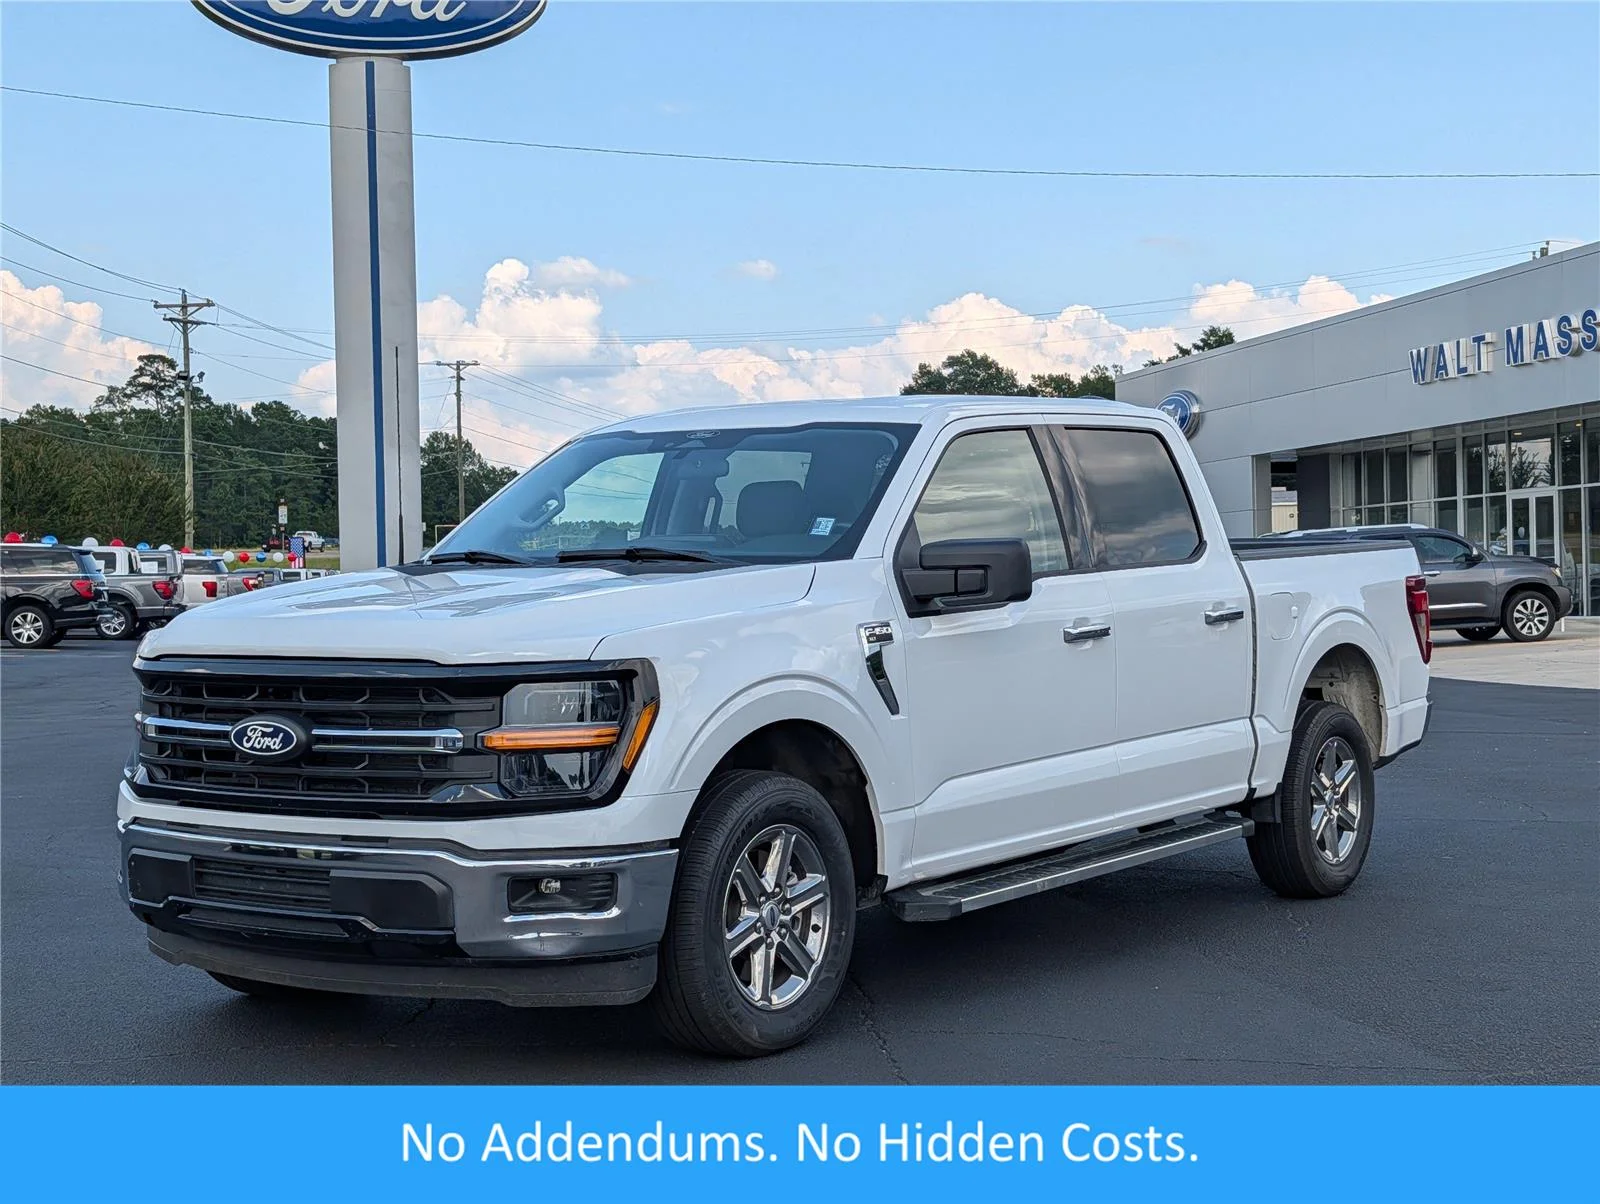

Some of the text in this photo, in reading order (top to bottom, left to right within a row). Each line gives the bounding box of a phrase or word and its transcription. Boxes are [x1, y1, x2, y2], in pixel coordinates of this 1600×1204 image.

[1408, 308, 1600, 385] WALT MASS
[242, 725, 283, 750] Ford
